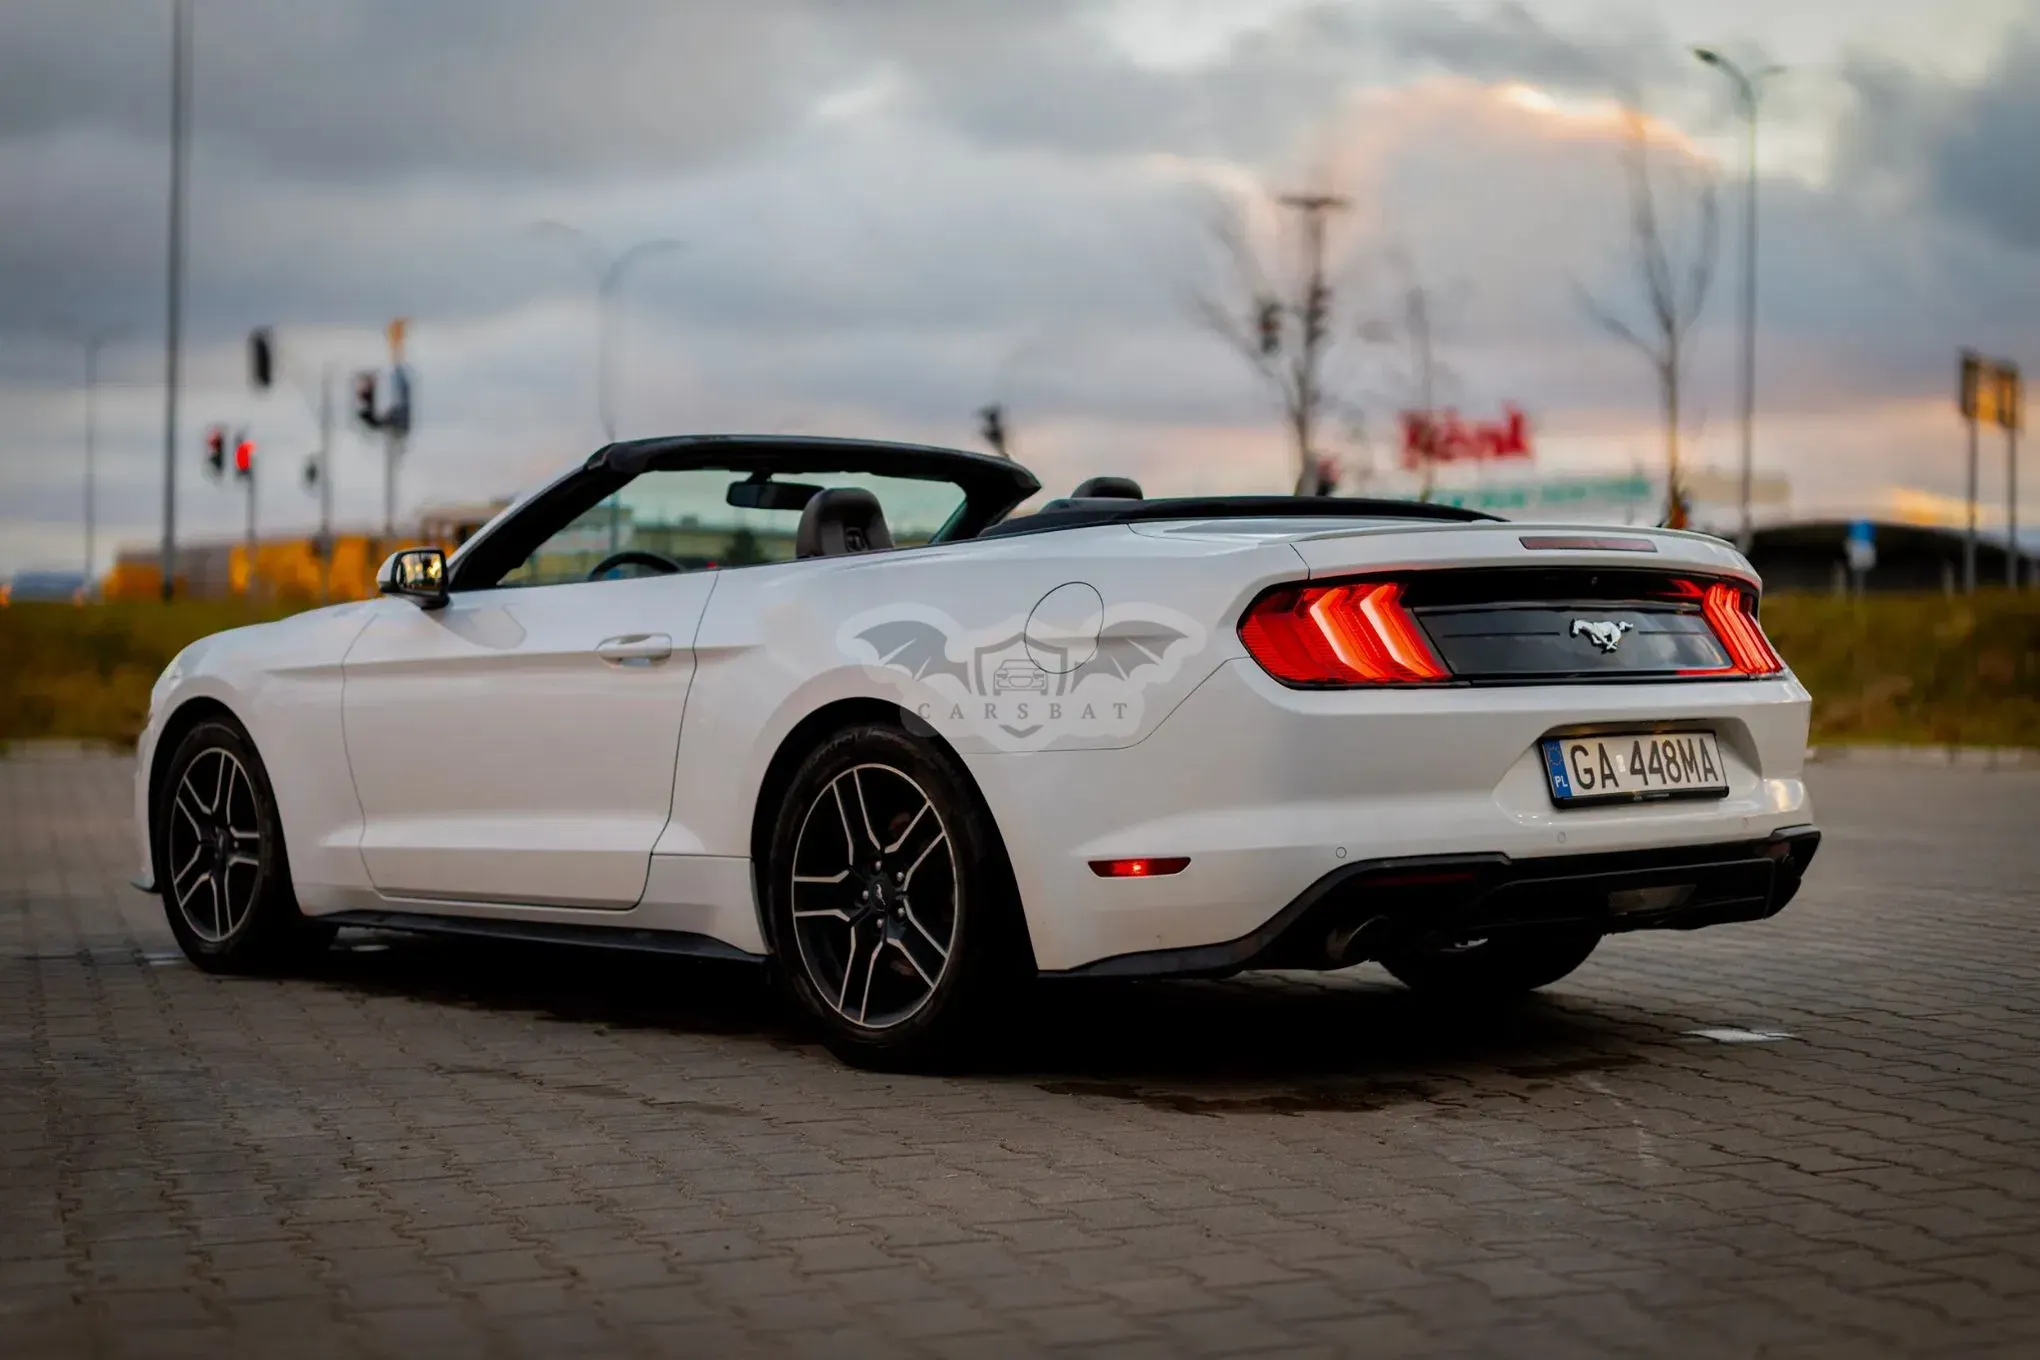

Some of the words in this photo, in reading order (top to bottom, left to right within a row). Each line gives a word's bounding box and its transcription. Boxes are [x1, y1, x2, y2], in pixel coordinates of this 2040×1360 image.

[1554, 774, 1569, 788] PL
[1569, 742, 1620, 791] GA
[1629, 737, 1719, 786] 448MA
